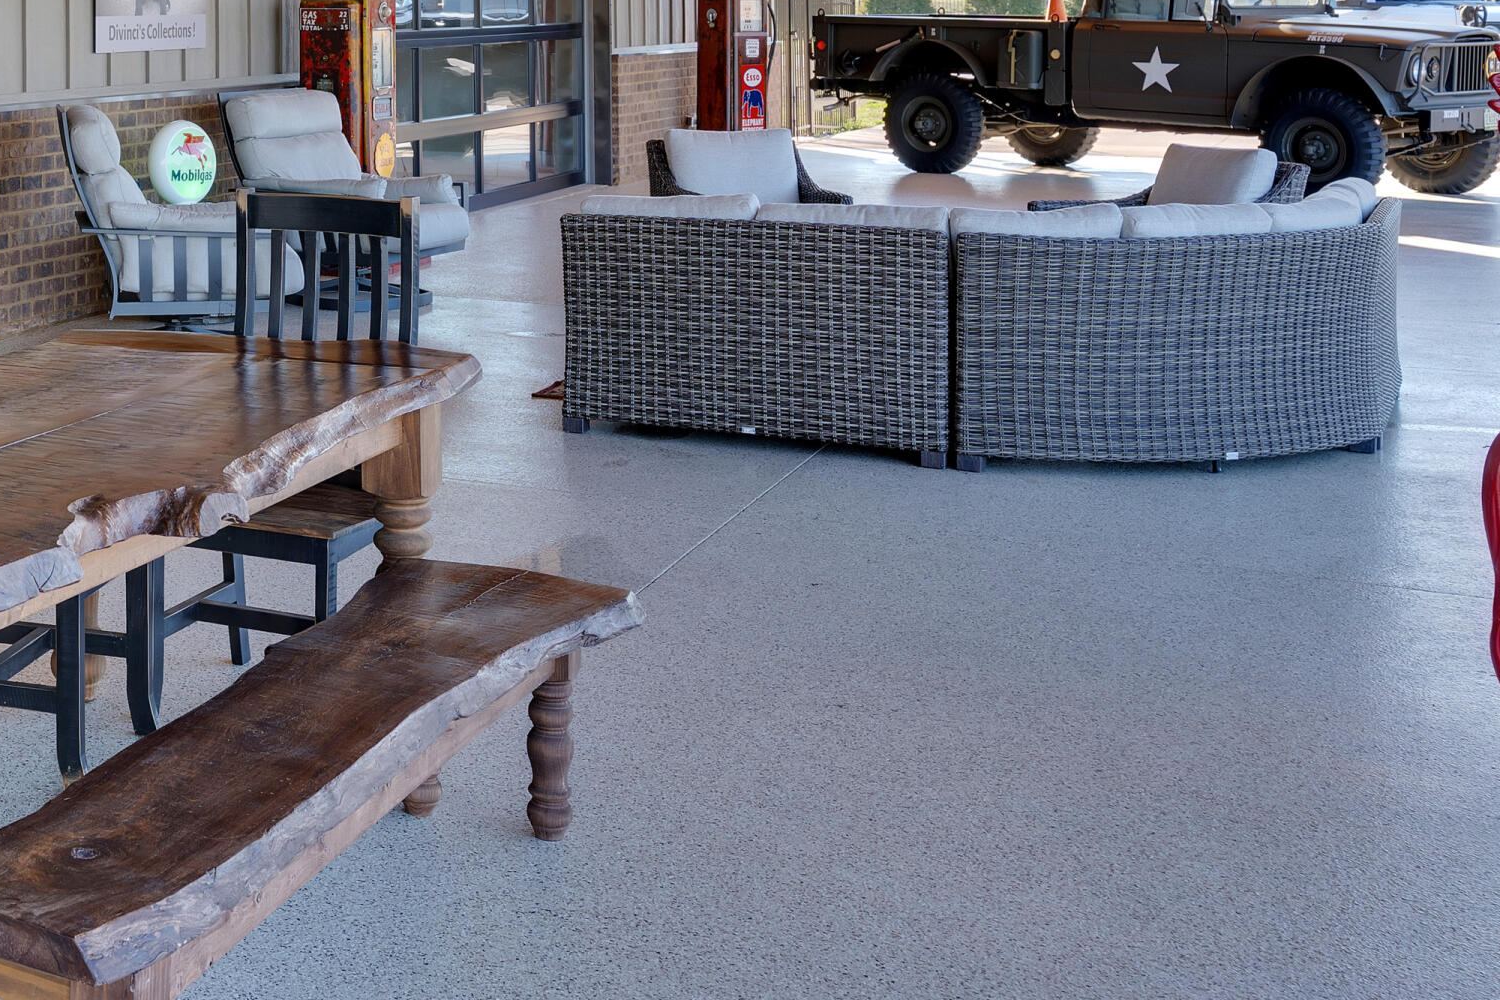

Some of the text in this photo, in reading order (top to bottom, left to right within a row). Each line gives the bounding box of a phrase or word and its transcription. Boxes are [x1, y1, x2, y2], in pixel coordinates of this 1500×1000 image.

[302, 10, 317, 19] GAS
[108, 22, 196, 41] Divinci's Collections!
[746, 72, 760, 81] Esso
[171, 169, 212, 184] Mobilgas
